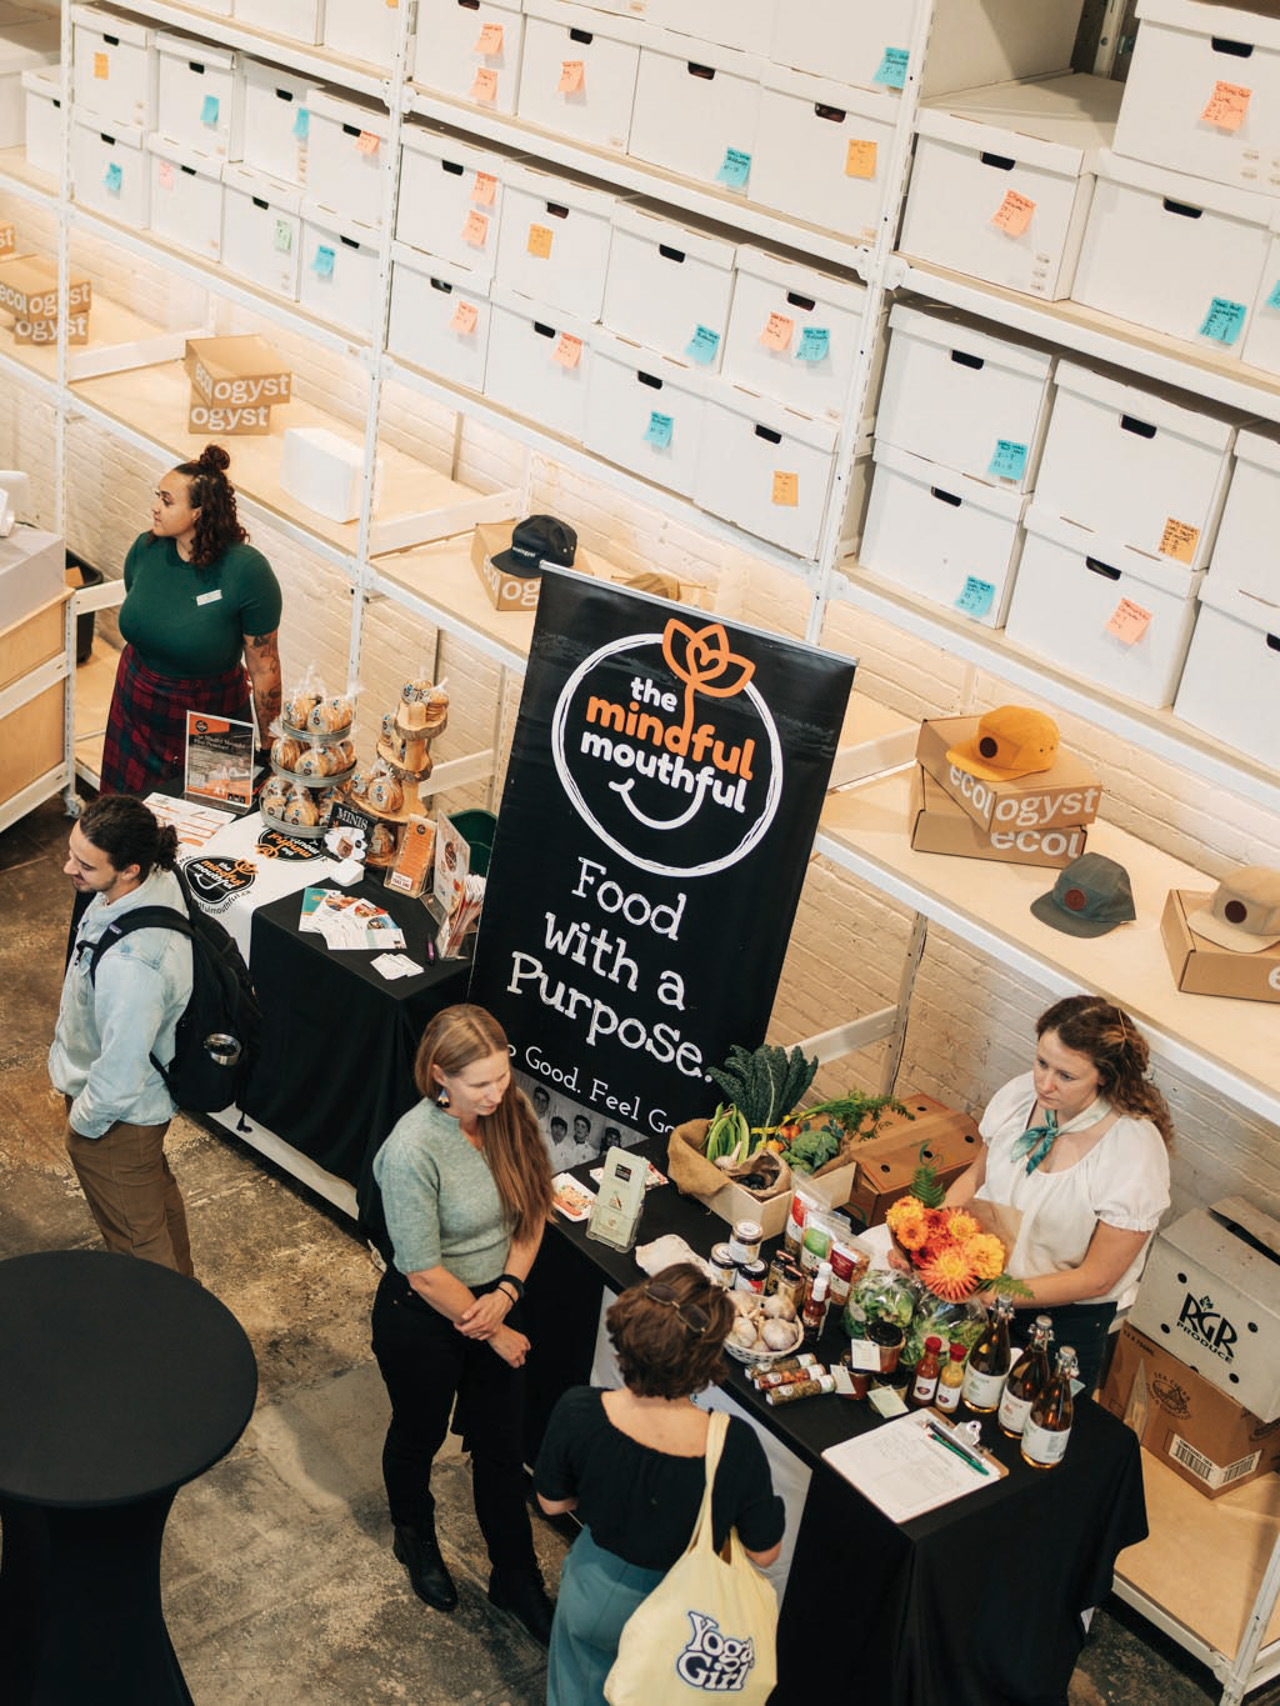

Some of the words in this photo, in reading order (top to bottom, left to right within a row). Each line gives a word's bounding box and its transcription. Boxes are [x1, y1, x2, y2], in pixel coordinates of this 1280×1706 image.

[190, 404, 270, 431] ogyst
[630, 676, 678, 712] the
[585, 695, 755, 781] mindful
[580, 731, 746, 814] mouthful
[336, 808, 369, 831] MINIS
[990, 830, 1080, 859] ecol
[571, 856, 687, 941] Food
[657, 970, 686, 1011] a
[506, 951, 713, 1083] Purpose.
[525, 1046, 581, 1094] Good.
[589, 1078, 640, 1121] Feel
[1176, 1321, 1234, 1364] PRODUCE
[1178, 1292, 1238, 1358] RGR
[685, 1611, 755, 1671] Yoga
[677, 1651, 751, 1691] Girl
